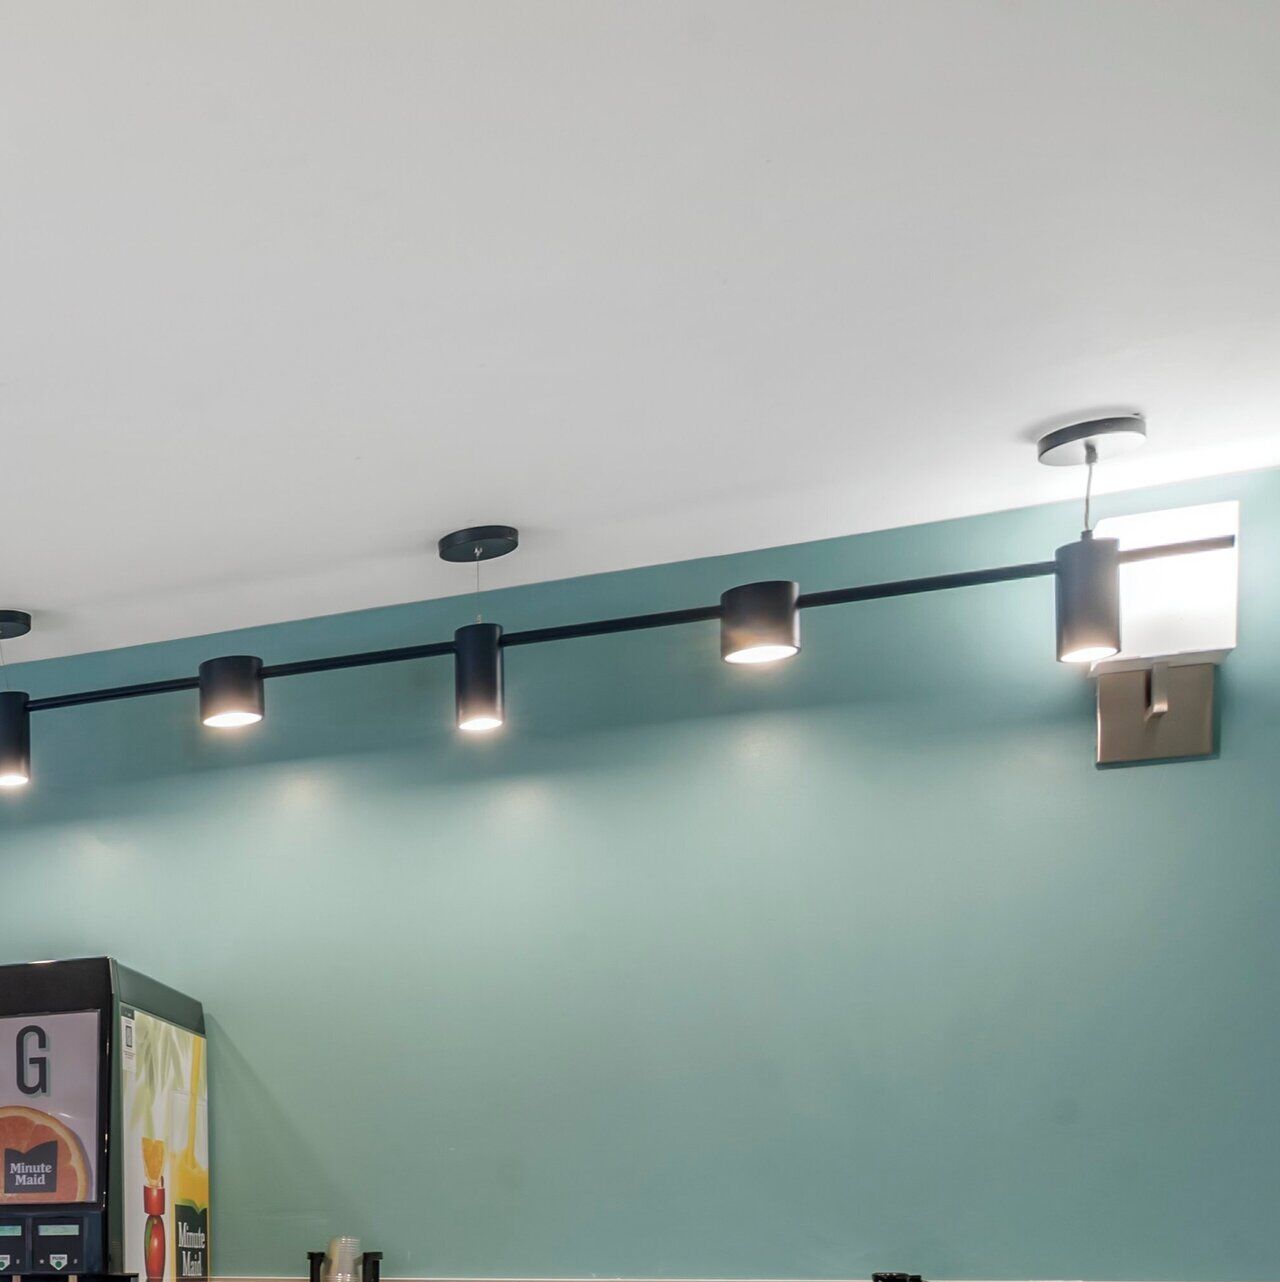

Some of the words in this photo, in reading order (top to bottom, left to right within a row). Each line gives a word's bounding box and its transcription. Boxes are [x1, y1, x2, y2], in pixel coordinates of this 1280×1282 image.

[15, 1024, 48, 1096] G
[9, 1162, 53, 1174] Minute
[14, 1173, 46, 1186] Maid
[177, 1220, 206, 1249] Minute
[181, 1250, 203, 1277] Maid
